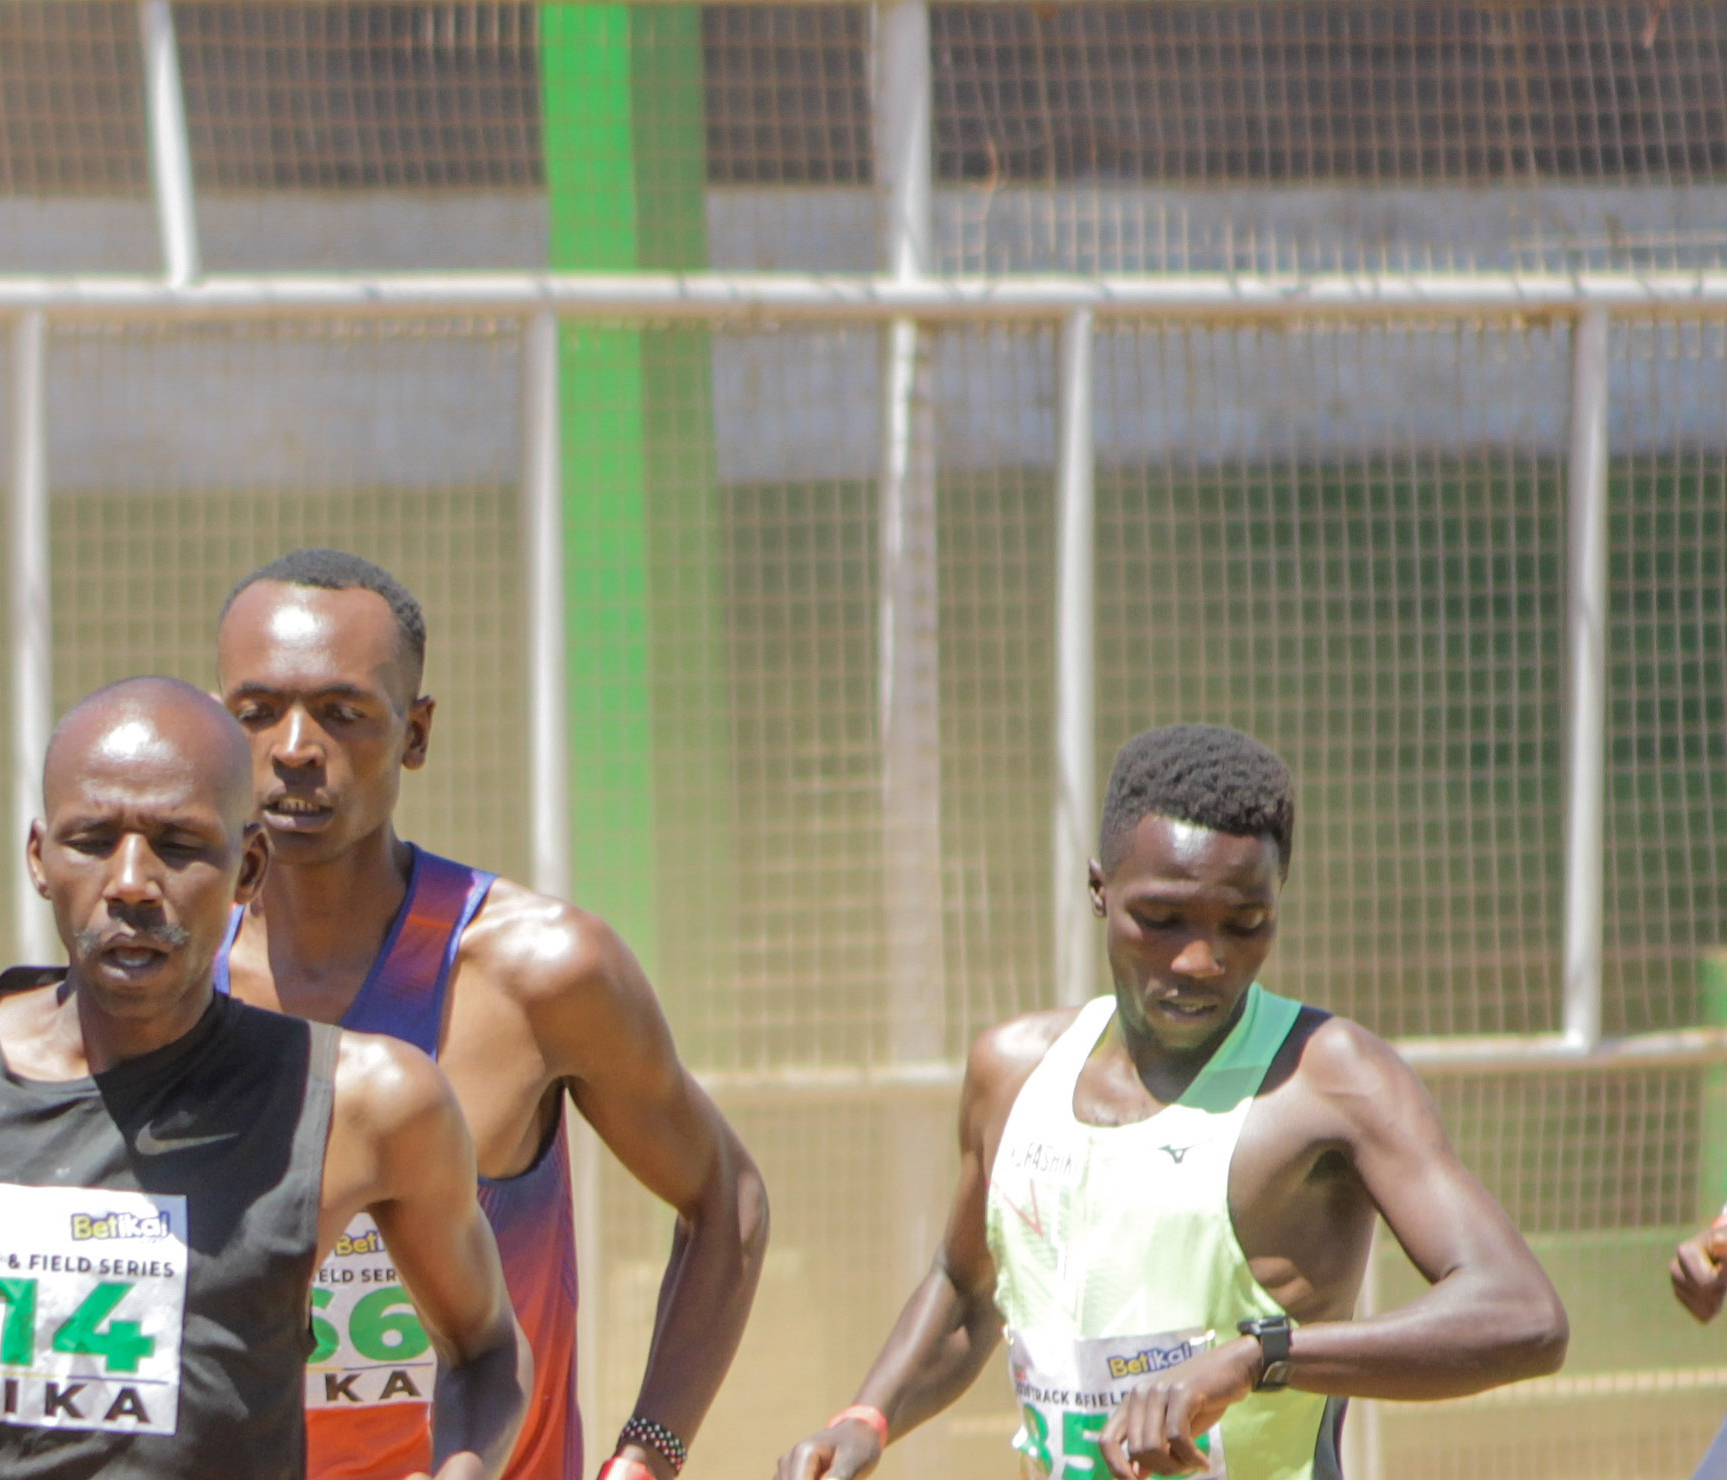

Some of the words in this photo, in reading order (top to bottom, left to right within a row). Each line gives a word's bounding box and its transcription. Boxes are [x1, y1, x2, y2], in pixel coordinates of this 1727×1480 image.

[8, 1253, 21, 1269] &
[28, 1254, 92, 1272] FIELD
[98, 1258, 175, 1278] SERIES
[361, 1268, 397, 1283] SER
[1107, 1341, 1193, 1379] Betika!
